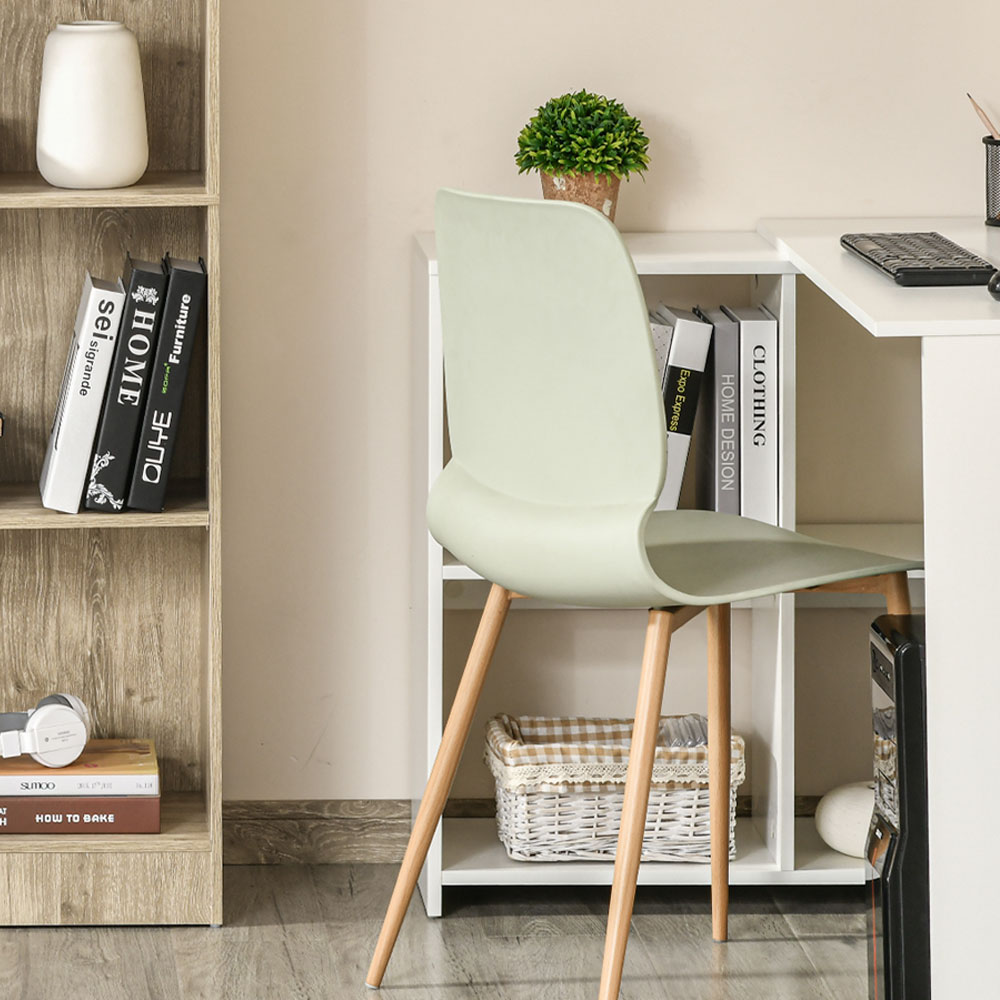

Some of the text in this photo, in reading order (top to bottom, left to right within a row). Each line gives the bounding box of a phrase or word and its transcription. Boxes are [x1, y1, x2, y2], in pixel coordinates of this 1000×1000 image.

[117, 308, 157, 407] HOME
[168, 293, 193, 364] Furniture
[670, 369, 691, 432] Expo Express
[721, 374, 734, 423] HOME
[752, 345, 766, 447] CLOTHING
[35, 813, 115, 823] HOW TO BAKE
